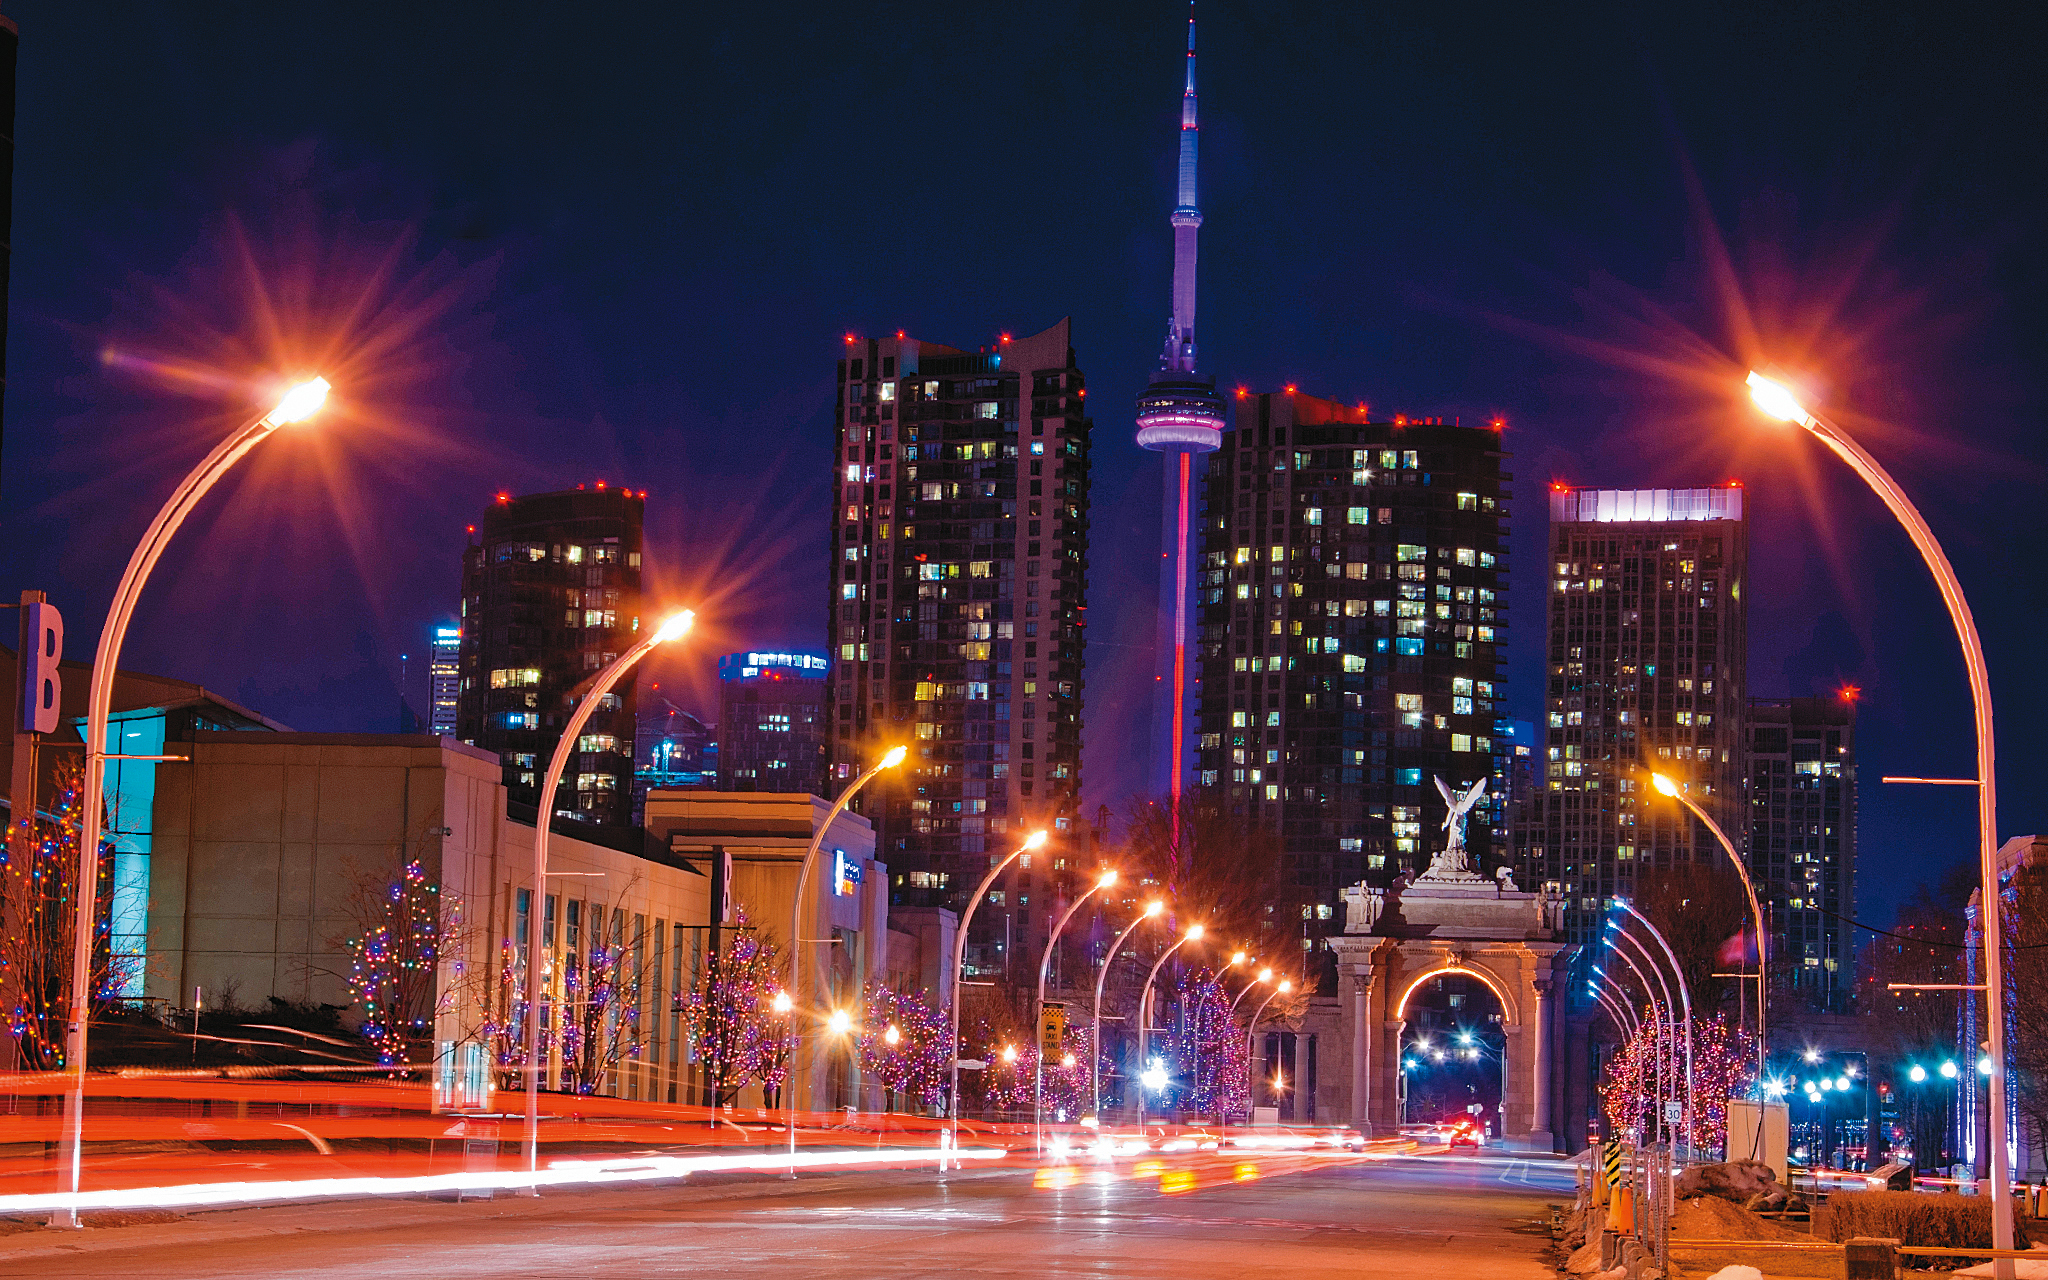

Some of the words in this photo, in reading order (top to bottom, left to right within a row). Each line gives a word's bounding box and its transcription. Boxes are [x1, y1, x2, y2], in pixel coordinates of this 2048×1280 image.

[34, 602, 64, 734] B
[722, 851, 733, 923] B
[1045, 1032, 1058, 1040] TAXI
[1042, 1041, 1060, 1050] STAND
[1667, 1109, 1680, 1120] 30
